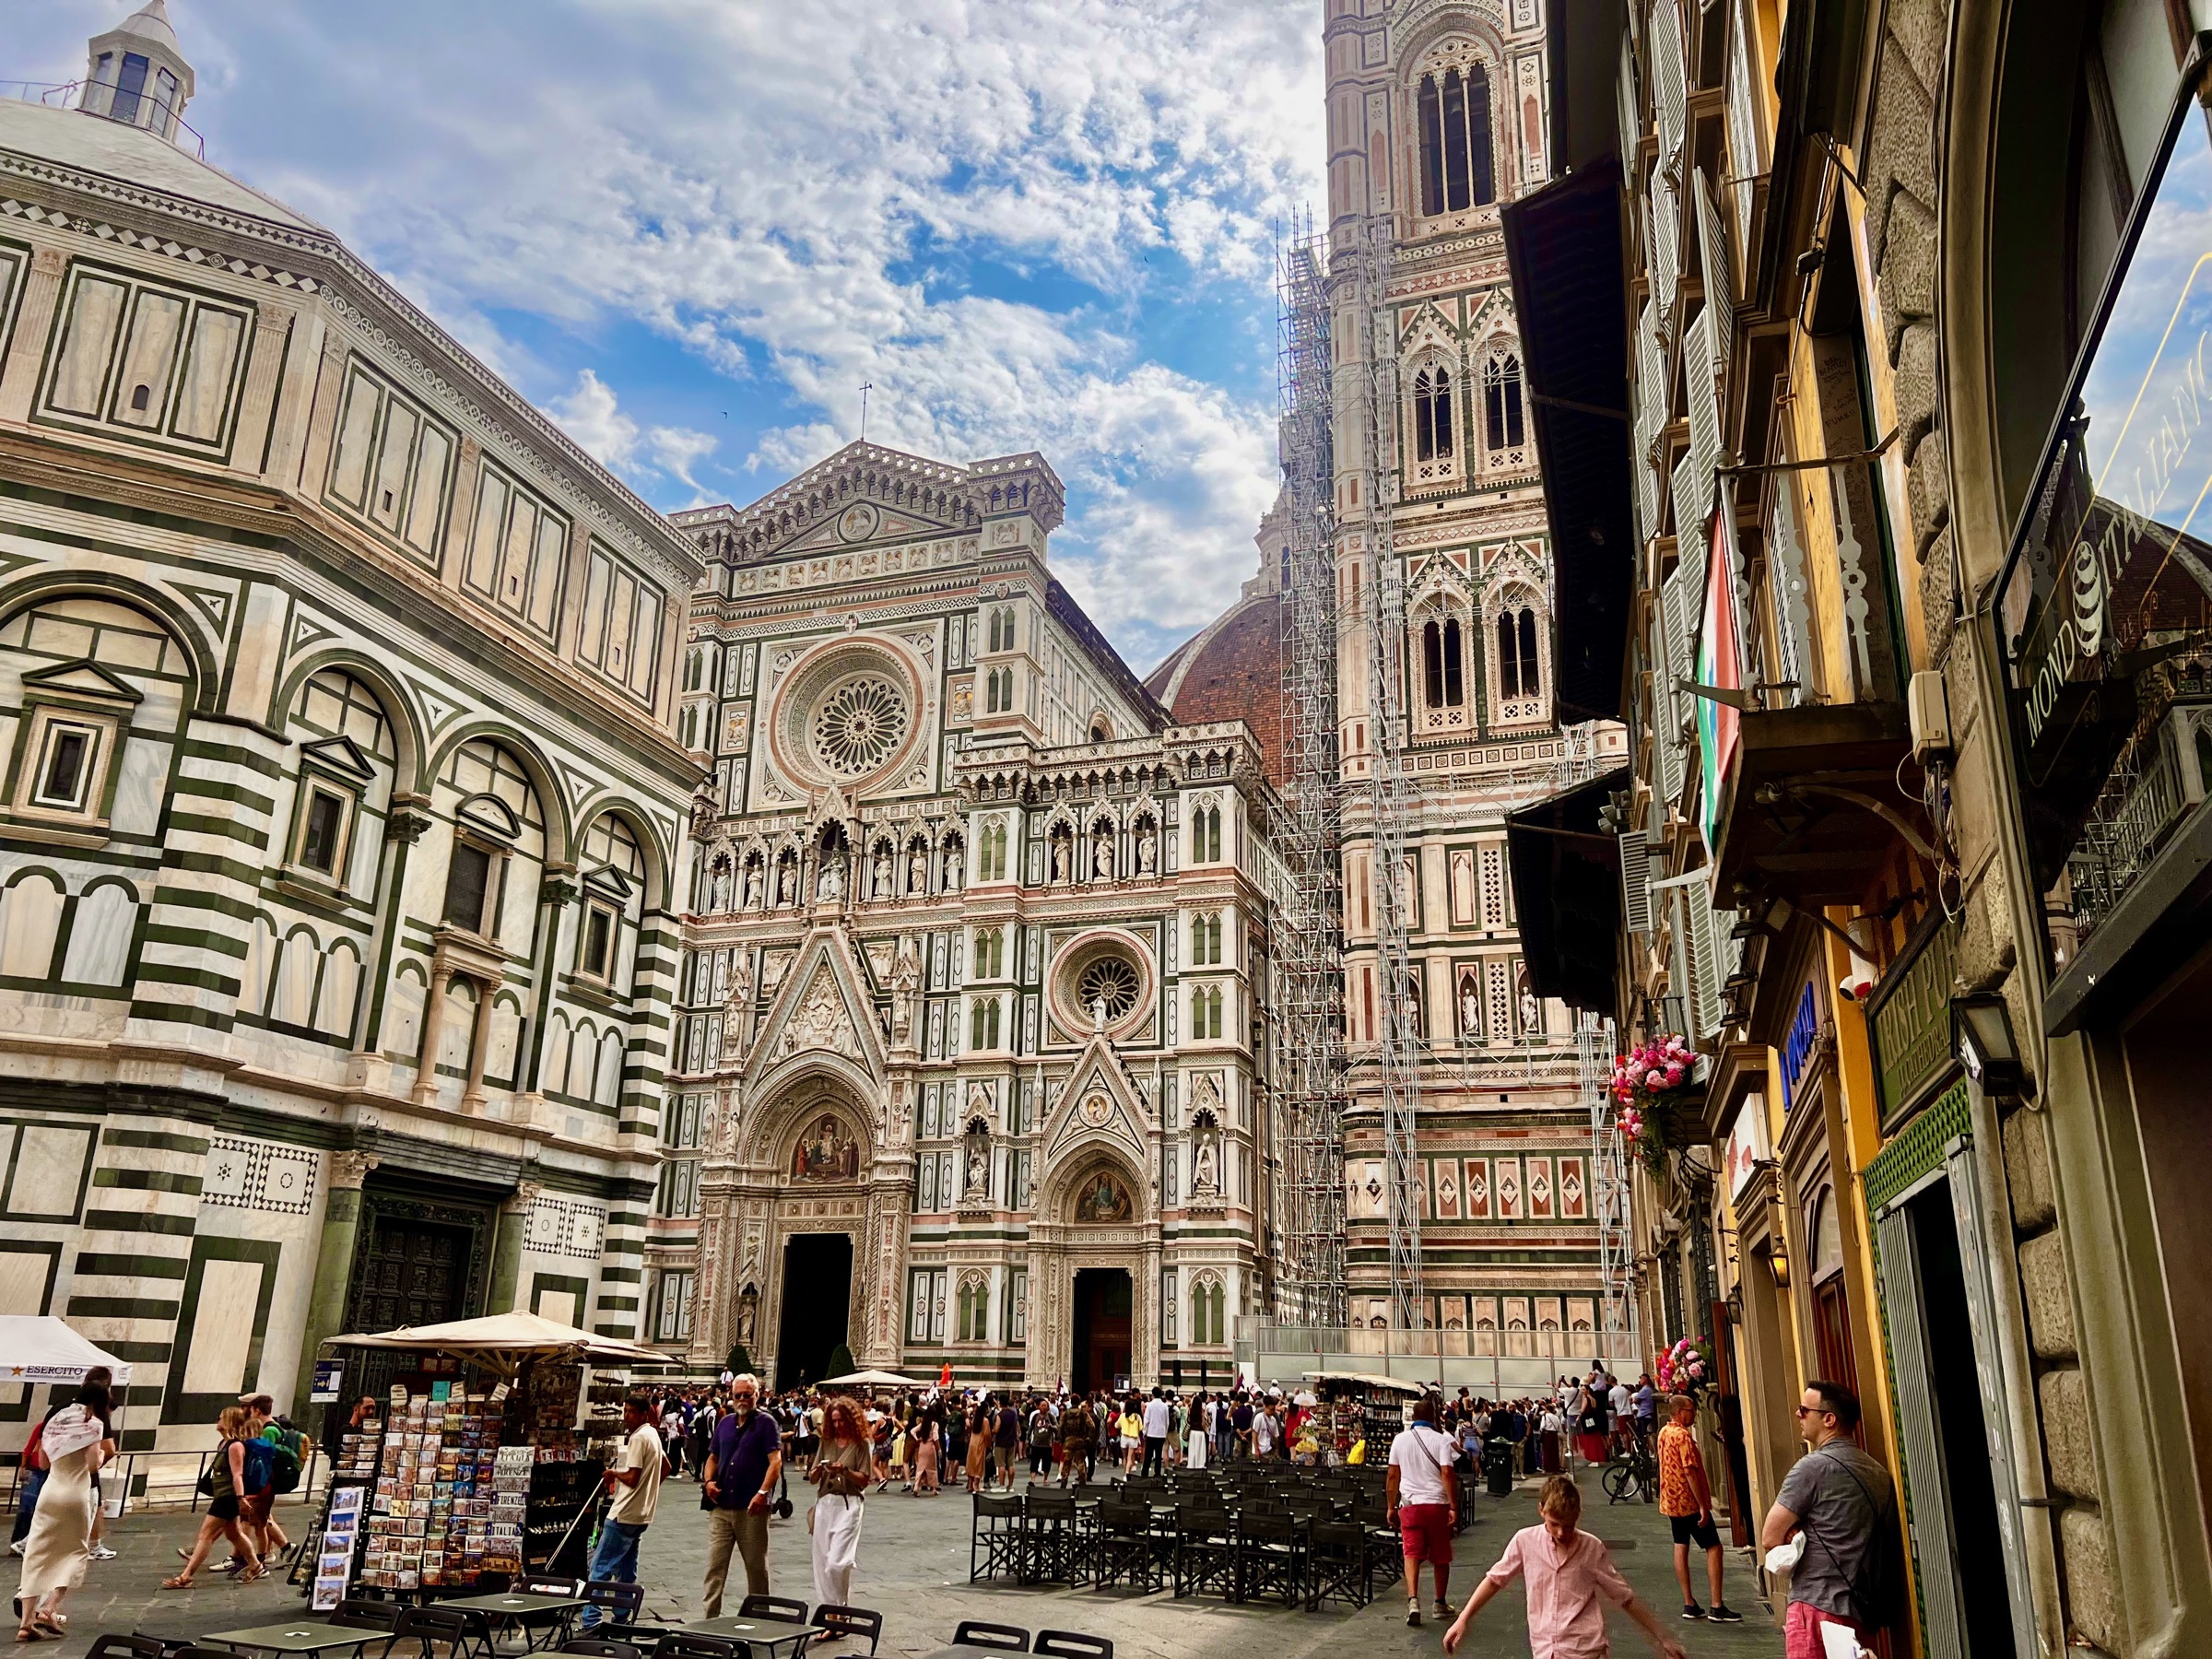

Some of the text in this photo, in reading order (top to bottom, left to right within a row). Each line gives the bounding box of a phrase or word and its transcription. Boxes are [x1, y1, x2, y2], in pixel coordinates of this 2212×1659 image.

[2100, 614, 2135, 686] FIRENZE
[1877, 970, 1924, 1076] IRISH
[26, 1365, 83, 1375] ESERCITO
[498, 1495, 522, 1505] FIRENZE
[491, 1526, 516, 1535] ITALIA
